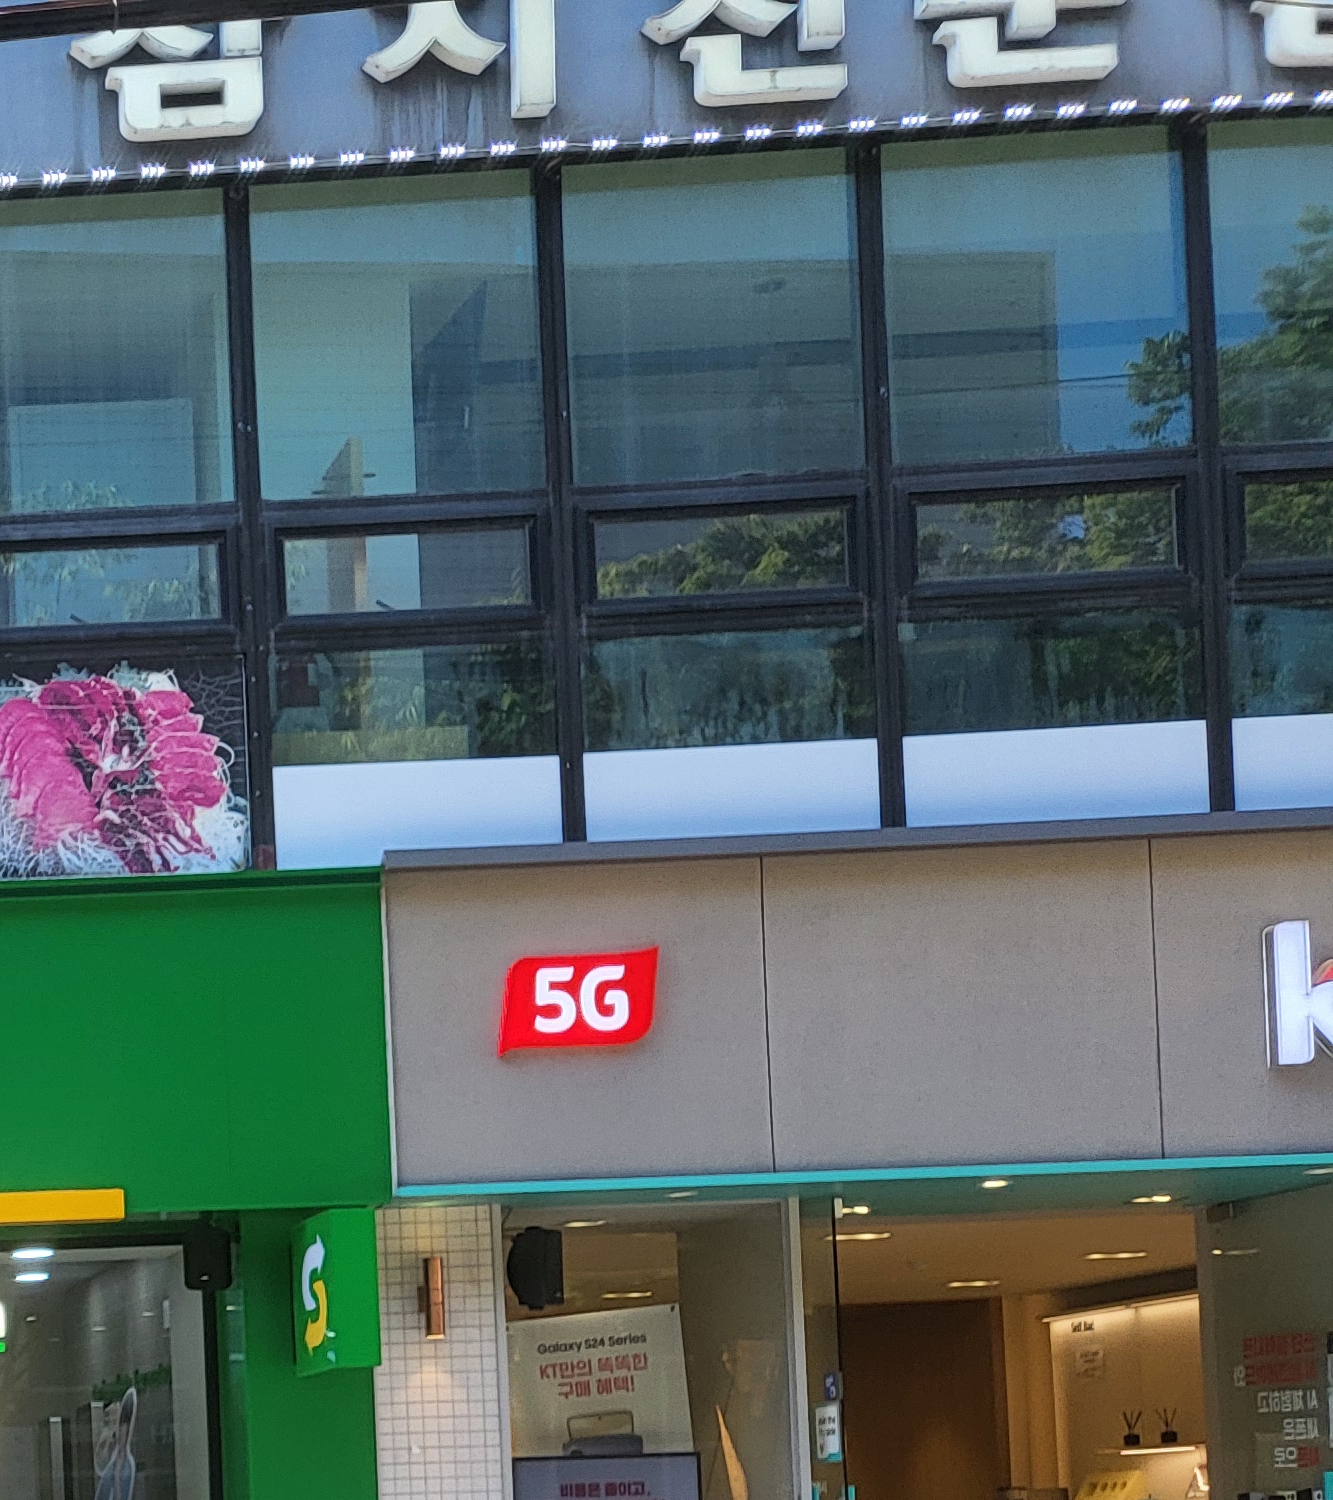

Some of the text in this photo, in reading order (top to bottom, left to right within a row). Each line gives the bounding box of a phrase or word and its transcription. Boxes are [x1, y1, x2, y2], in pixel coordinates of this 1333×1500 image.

[532, 964, 631, 1033] 5G
[538, 1333, 647, 1355] Galaxy S24 Series
